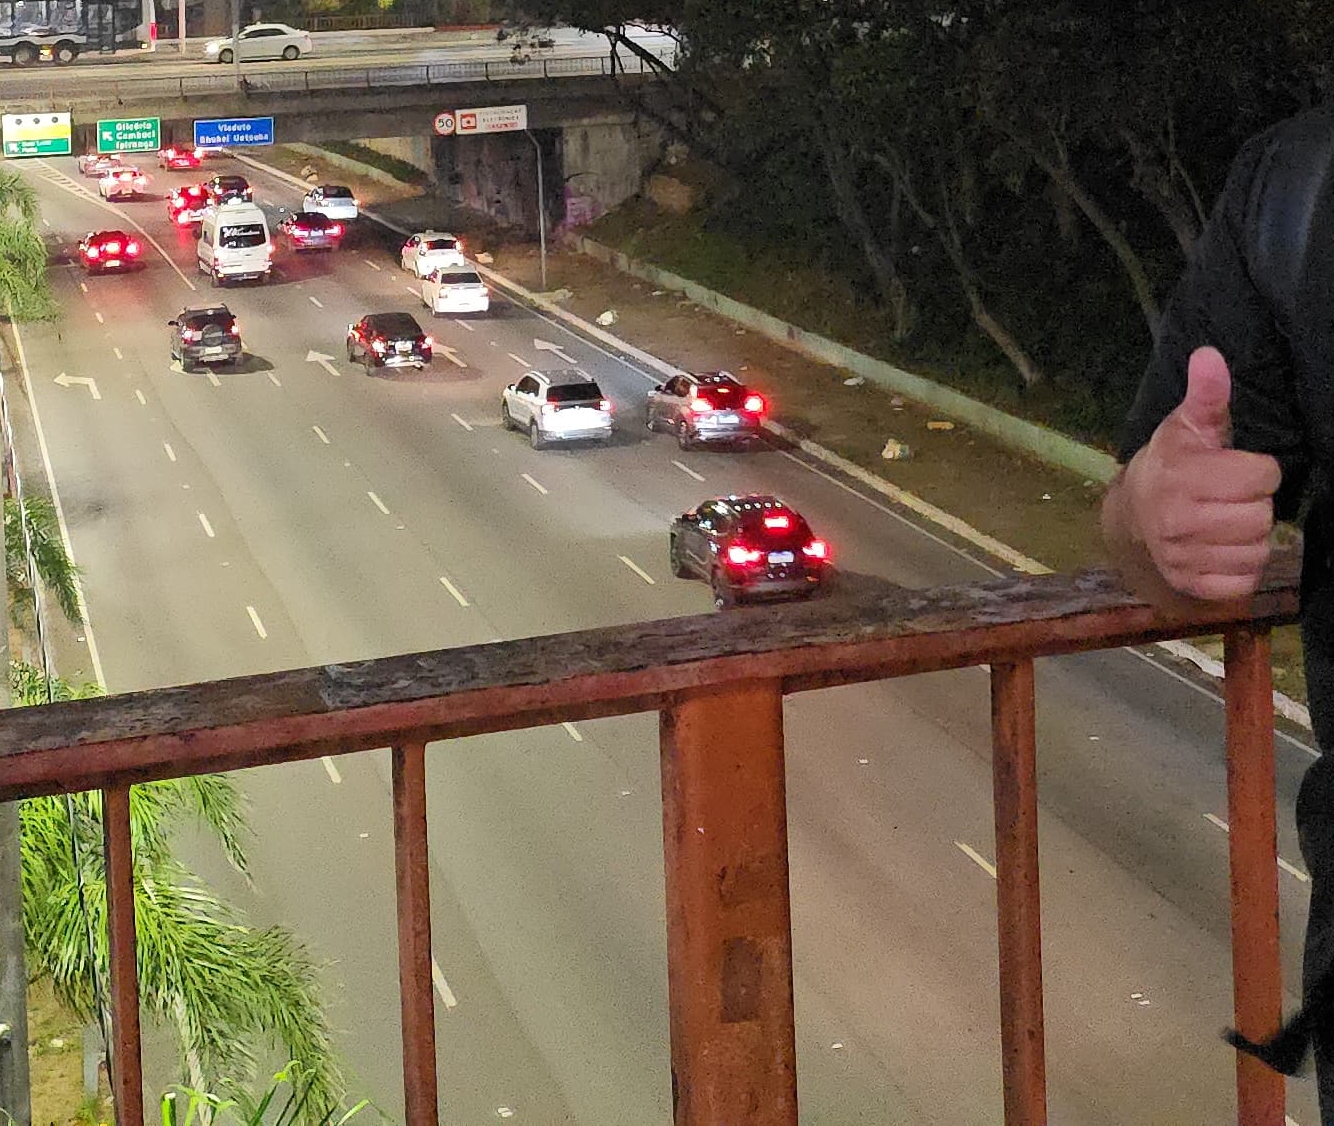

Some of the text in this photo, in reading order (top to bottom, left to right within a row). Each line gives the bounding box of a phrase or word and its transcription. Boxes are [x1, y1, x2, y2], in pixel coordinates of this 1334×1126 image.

[218, 123, 252, 132] Viaduto
[438, 118, 453, 128] 50
[115, 130, 156, 140] Cambuci
[115, 140, 154, 150] Ipiranga
